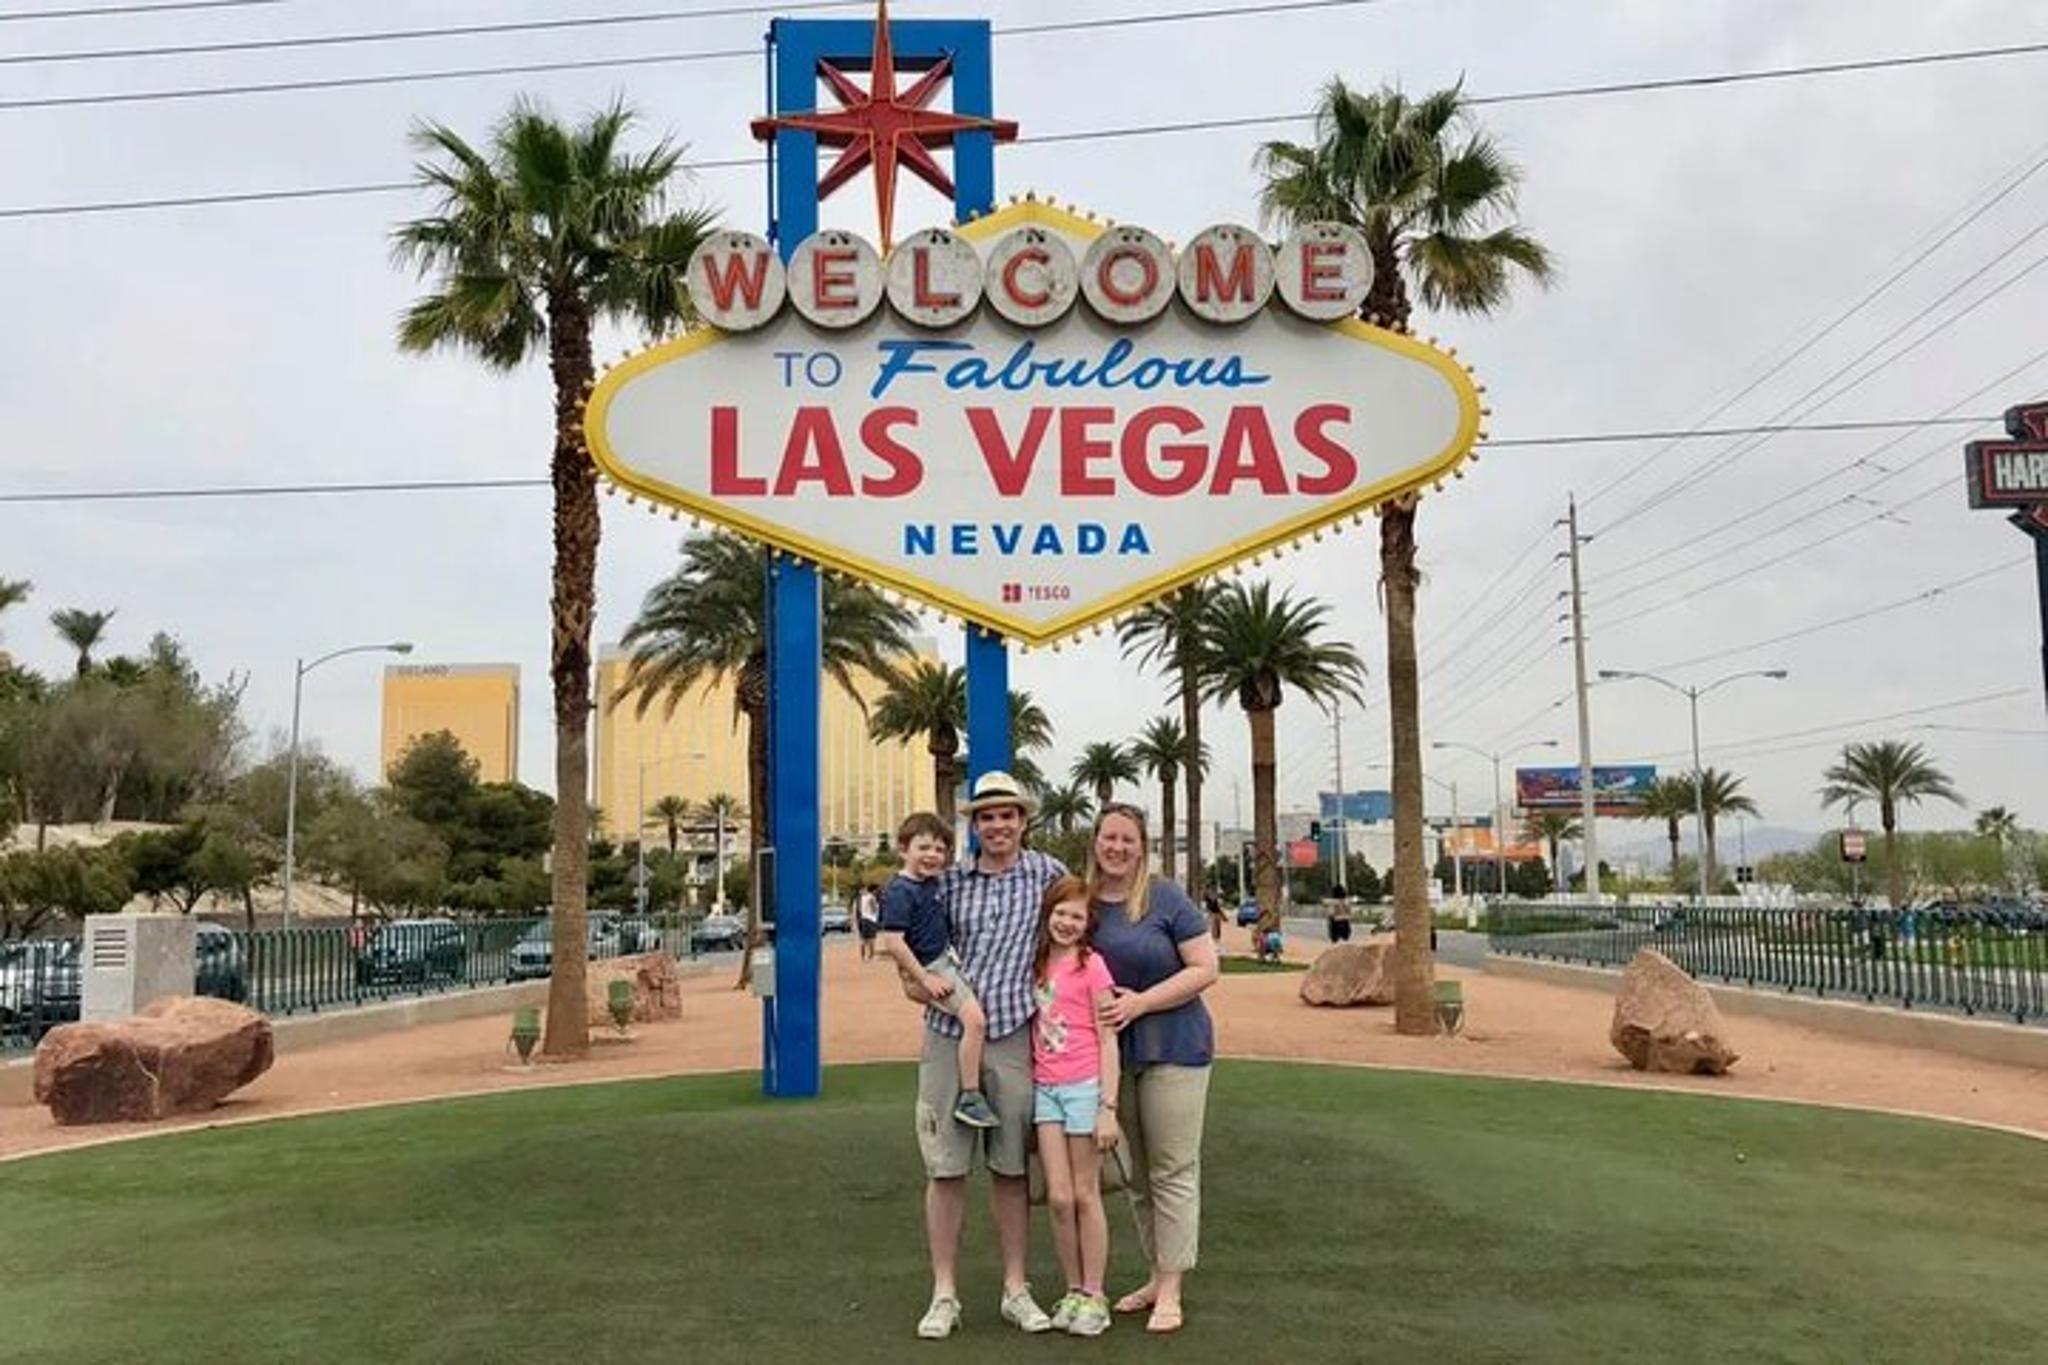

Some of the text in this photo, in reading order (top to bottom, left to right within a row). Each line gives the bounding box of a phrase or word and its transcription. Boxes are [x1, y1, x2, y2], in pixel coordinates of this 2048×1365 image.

[702, 242, 1347, 312] WELCOME
[774, 338, 1271, 398] TO Fabulous
[710, 404, 1358, 497] LAS VEGAS
[905, 524, 1150, 556] NEVADA
